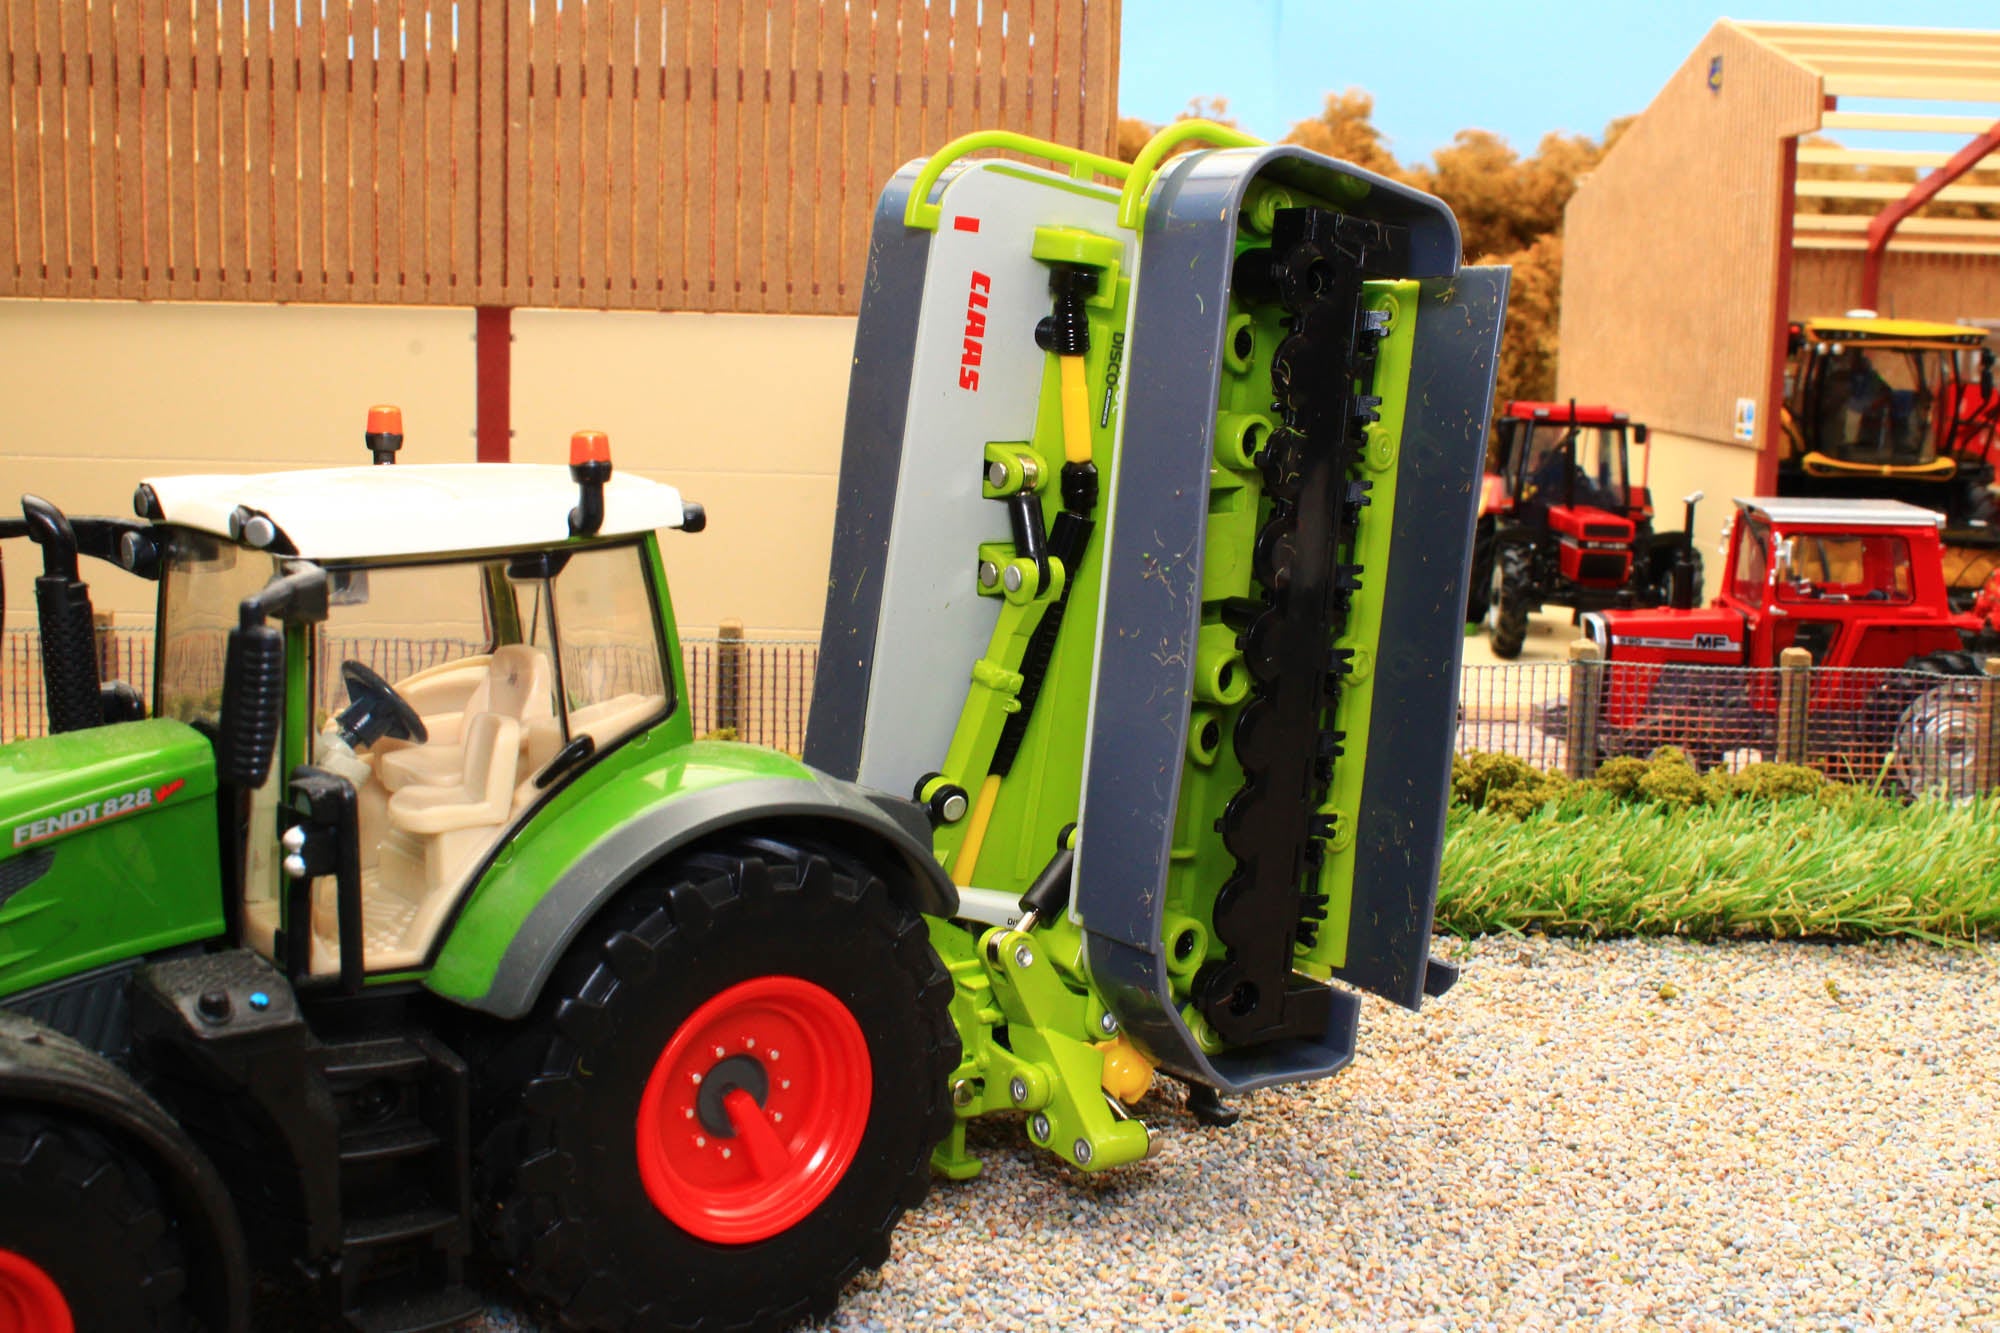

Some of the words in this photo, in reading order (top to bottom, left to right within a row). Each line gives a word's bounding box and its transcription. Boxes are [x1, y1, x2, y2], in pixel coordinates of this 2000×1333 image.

[959, 270, 991, 392] CLAAS
[1105, 332, 1125, 386] DISCO
[1696, 636, 1728, 649] MF
[13, 802, 100, 844] FENDT
[103, 787, 153, 817] 828
